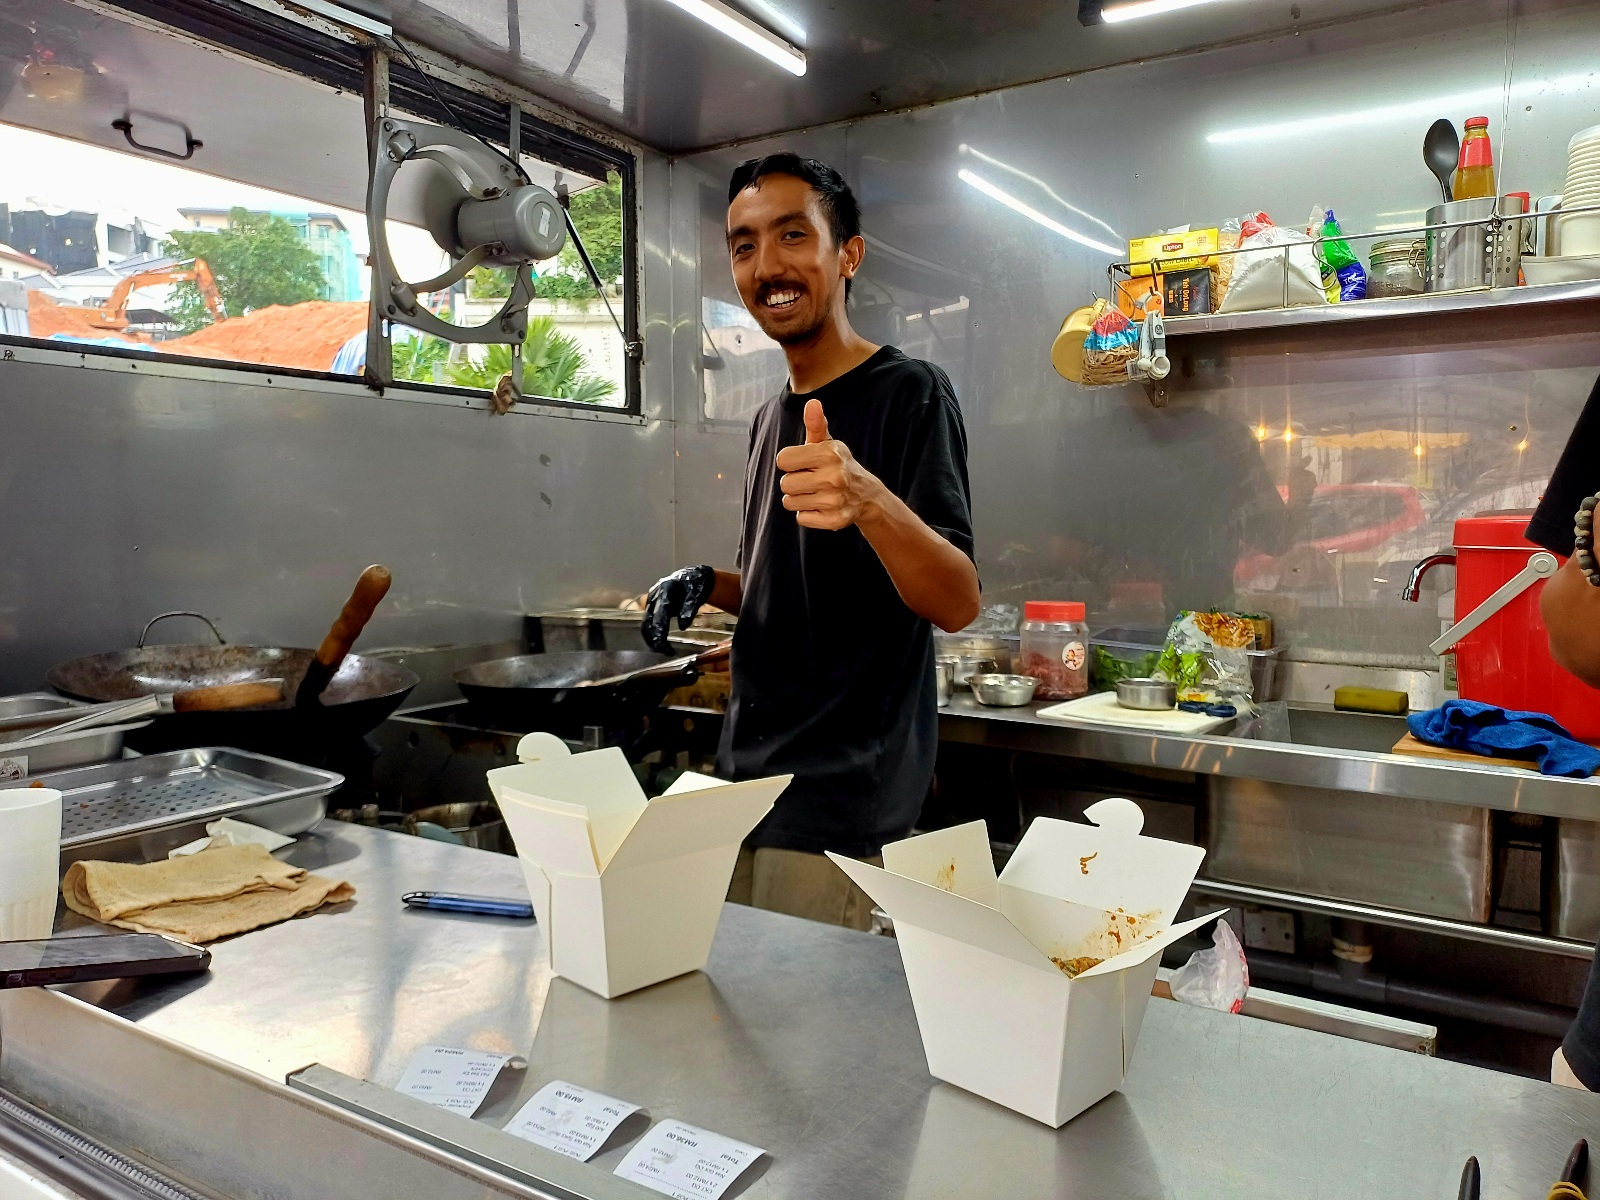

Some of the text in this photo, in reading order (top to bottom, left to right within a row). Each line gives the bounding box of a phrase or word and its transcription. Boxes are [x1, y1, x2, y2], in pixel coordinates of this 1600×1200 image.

[602, 1106, 620, 1117] Total
[666, 1132, 698, 1148] RM36.00
[720, 1152, 739, 1165] Total
